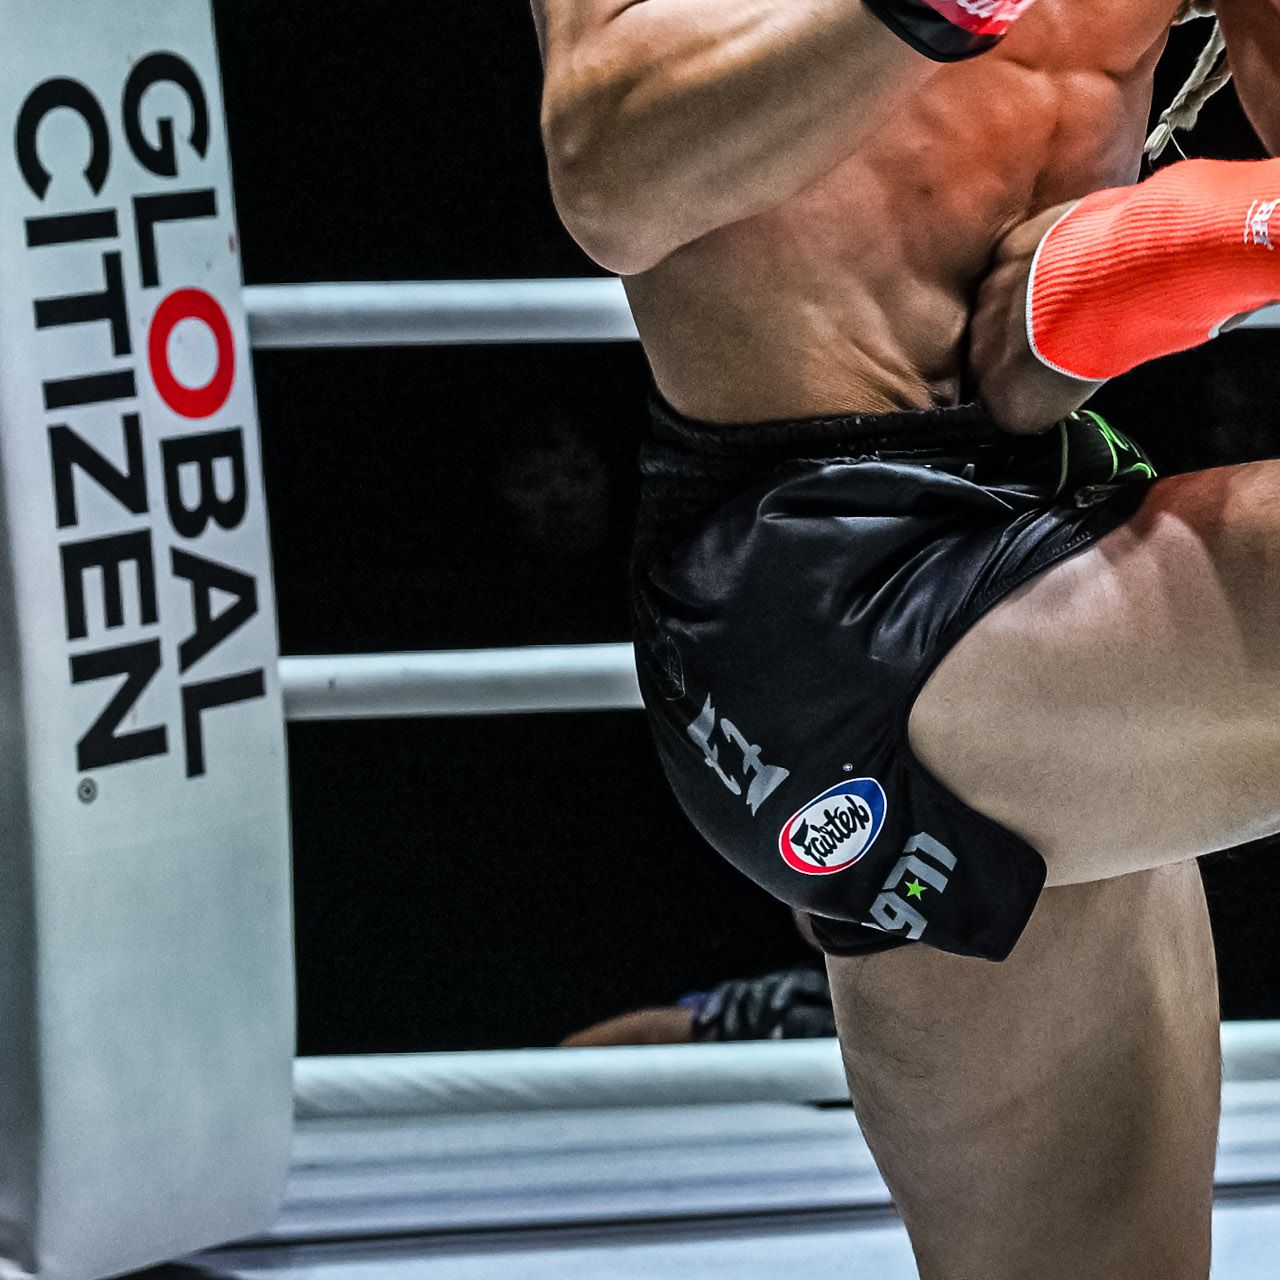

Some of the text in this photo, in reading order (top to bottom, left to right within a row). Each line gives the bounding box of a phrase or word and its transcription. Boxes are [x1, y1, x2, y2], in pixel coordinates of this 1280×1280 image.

[14, 76, 170, 773] CITIZEN
[121, 50, 267, 778] GLOBAL
[789, 795, 870, 866] Fairtex
[863, 831, 958, 940] 971
